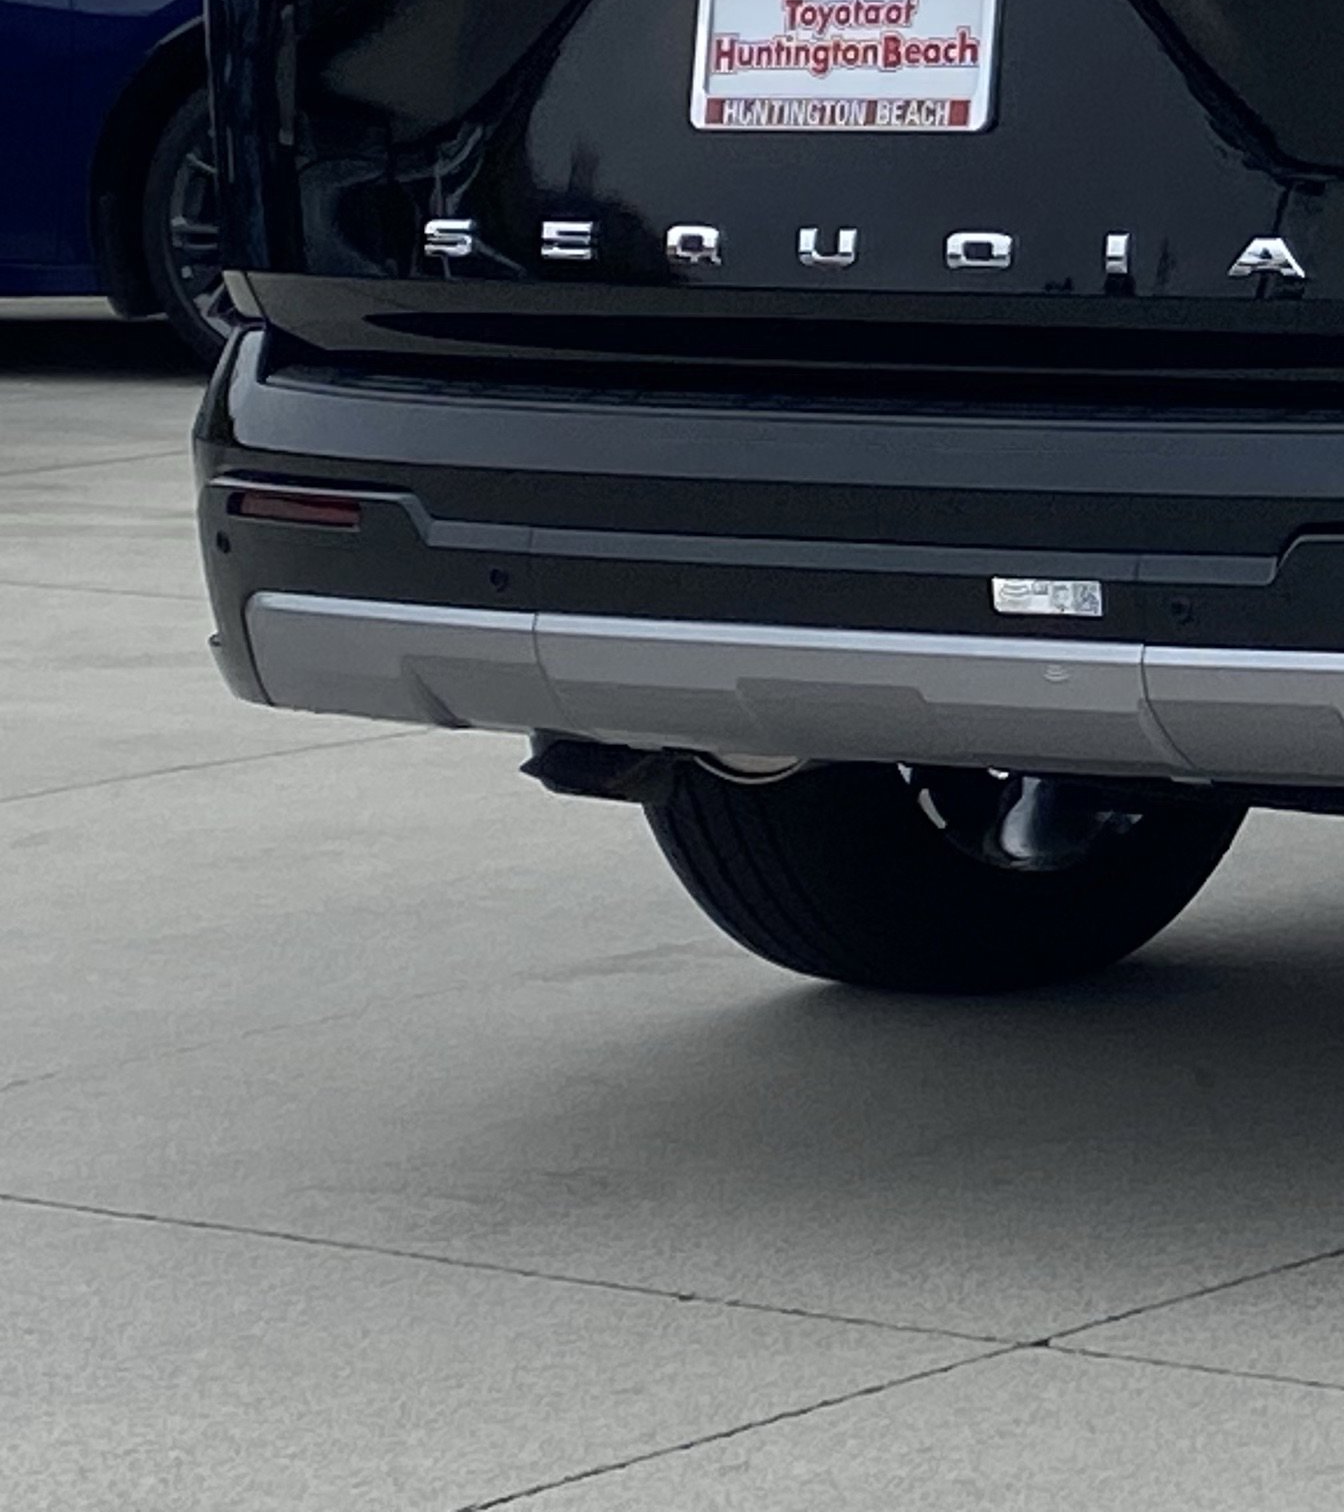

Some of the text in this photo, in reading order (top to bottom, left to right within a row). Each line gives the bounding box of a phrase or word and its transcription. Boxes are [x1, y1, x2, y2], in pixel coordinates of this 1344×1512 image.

[714, 28, 980, 76] Huntington Beach
[722, 99, 950, 126] HUNTINGTON BEACH
[424, 219, 1305, 278] SEQUOIA
